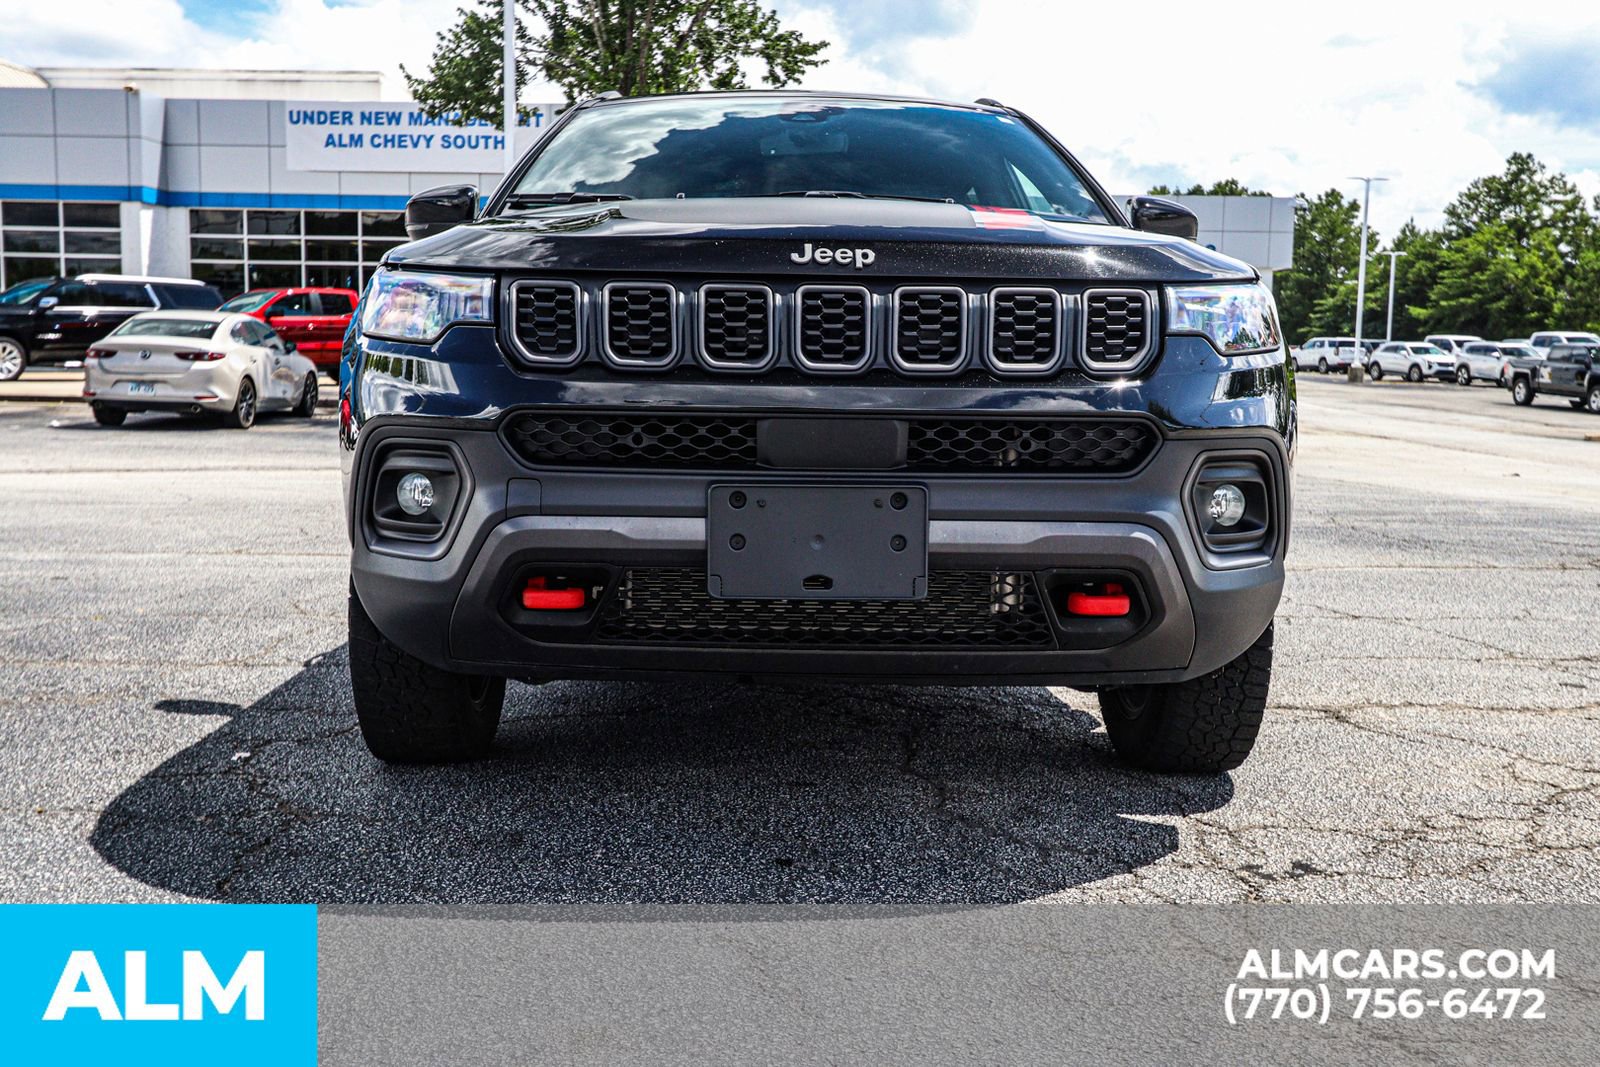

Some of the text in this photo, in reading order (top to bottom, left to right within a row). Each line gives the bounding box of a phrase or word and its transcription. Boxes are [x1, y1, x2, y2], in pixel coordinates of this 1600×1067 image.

[289, 110, 353, 125] UNDER
[360, 111, 402, 126] NEW
[325, 134, 505, 149] ALM CHEVY SOUTH
[790, 243, 876, 269] Jeep
